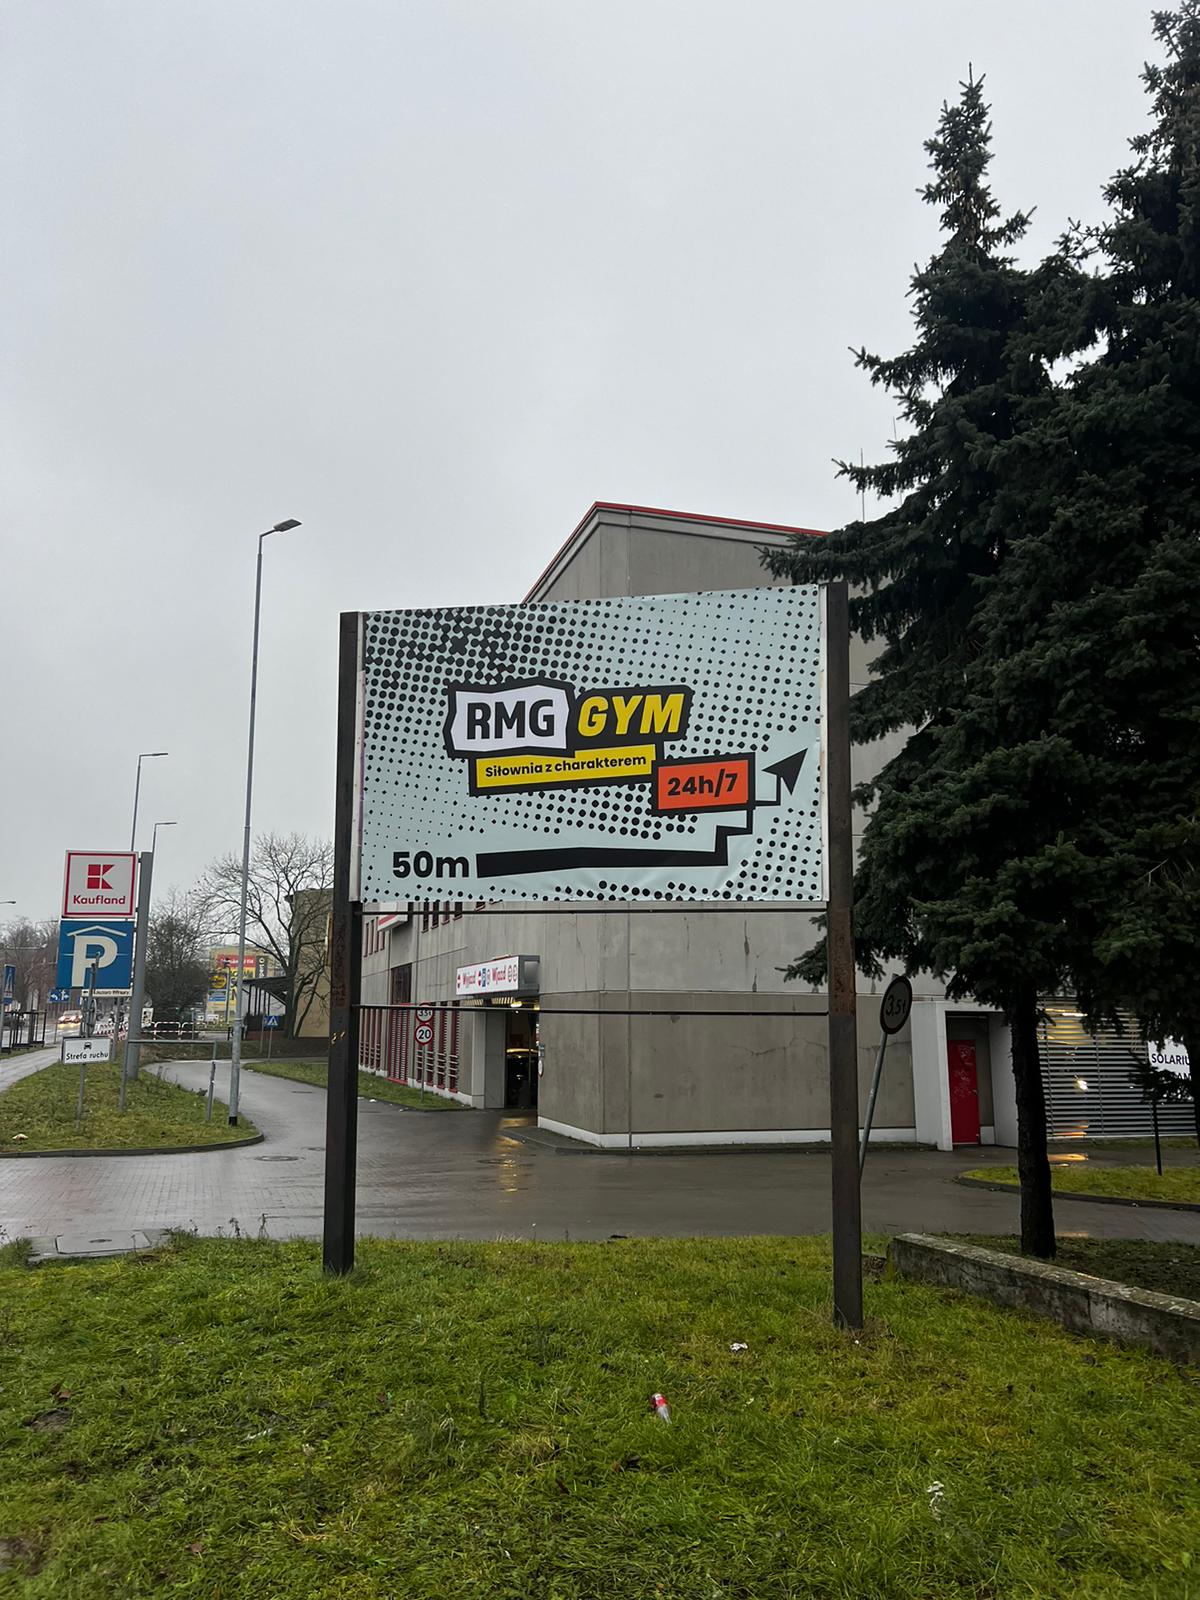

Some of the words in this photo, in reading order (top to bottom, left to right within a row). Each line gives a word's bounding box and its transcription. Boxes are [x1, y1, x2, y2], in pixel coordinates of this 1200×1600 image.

[466, 698, 555, 741] RMG
[577, 693, 683, 737] GYM
[485, 761, 543, 778] Siłownia
[545, 762, 553, 773] z
[554, 753, 647, 773] charakterem
[667, 769, 738, 799] 24h/7
[392, 850, 470, 879] 50m
[73, 894, 126, 905] Kaufland
[418, 1029, 431, 1040] 20
[65, 1051, 87, 1061] Strefa
[89, 1051, 109, 1060] ruchu
[1151, 1053, 1190, 1065] SOLARIU
